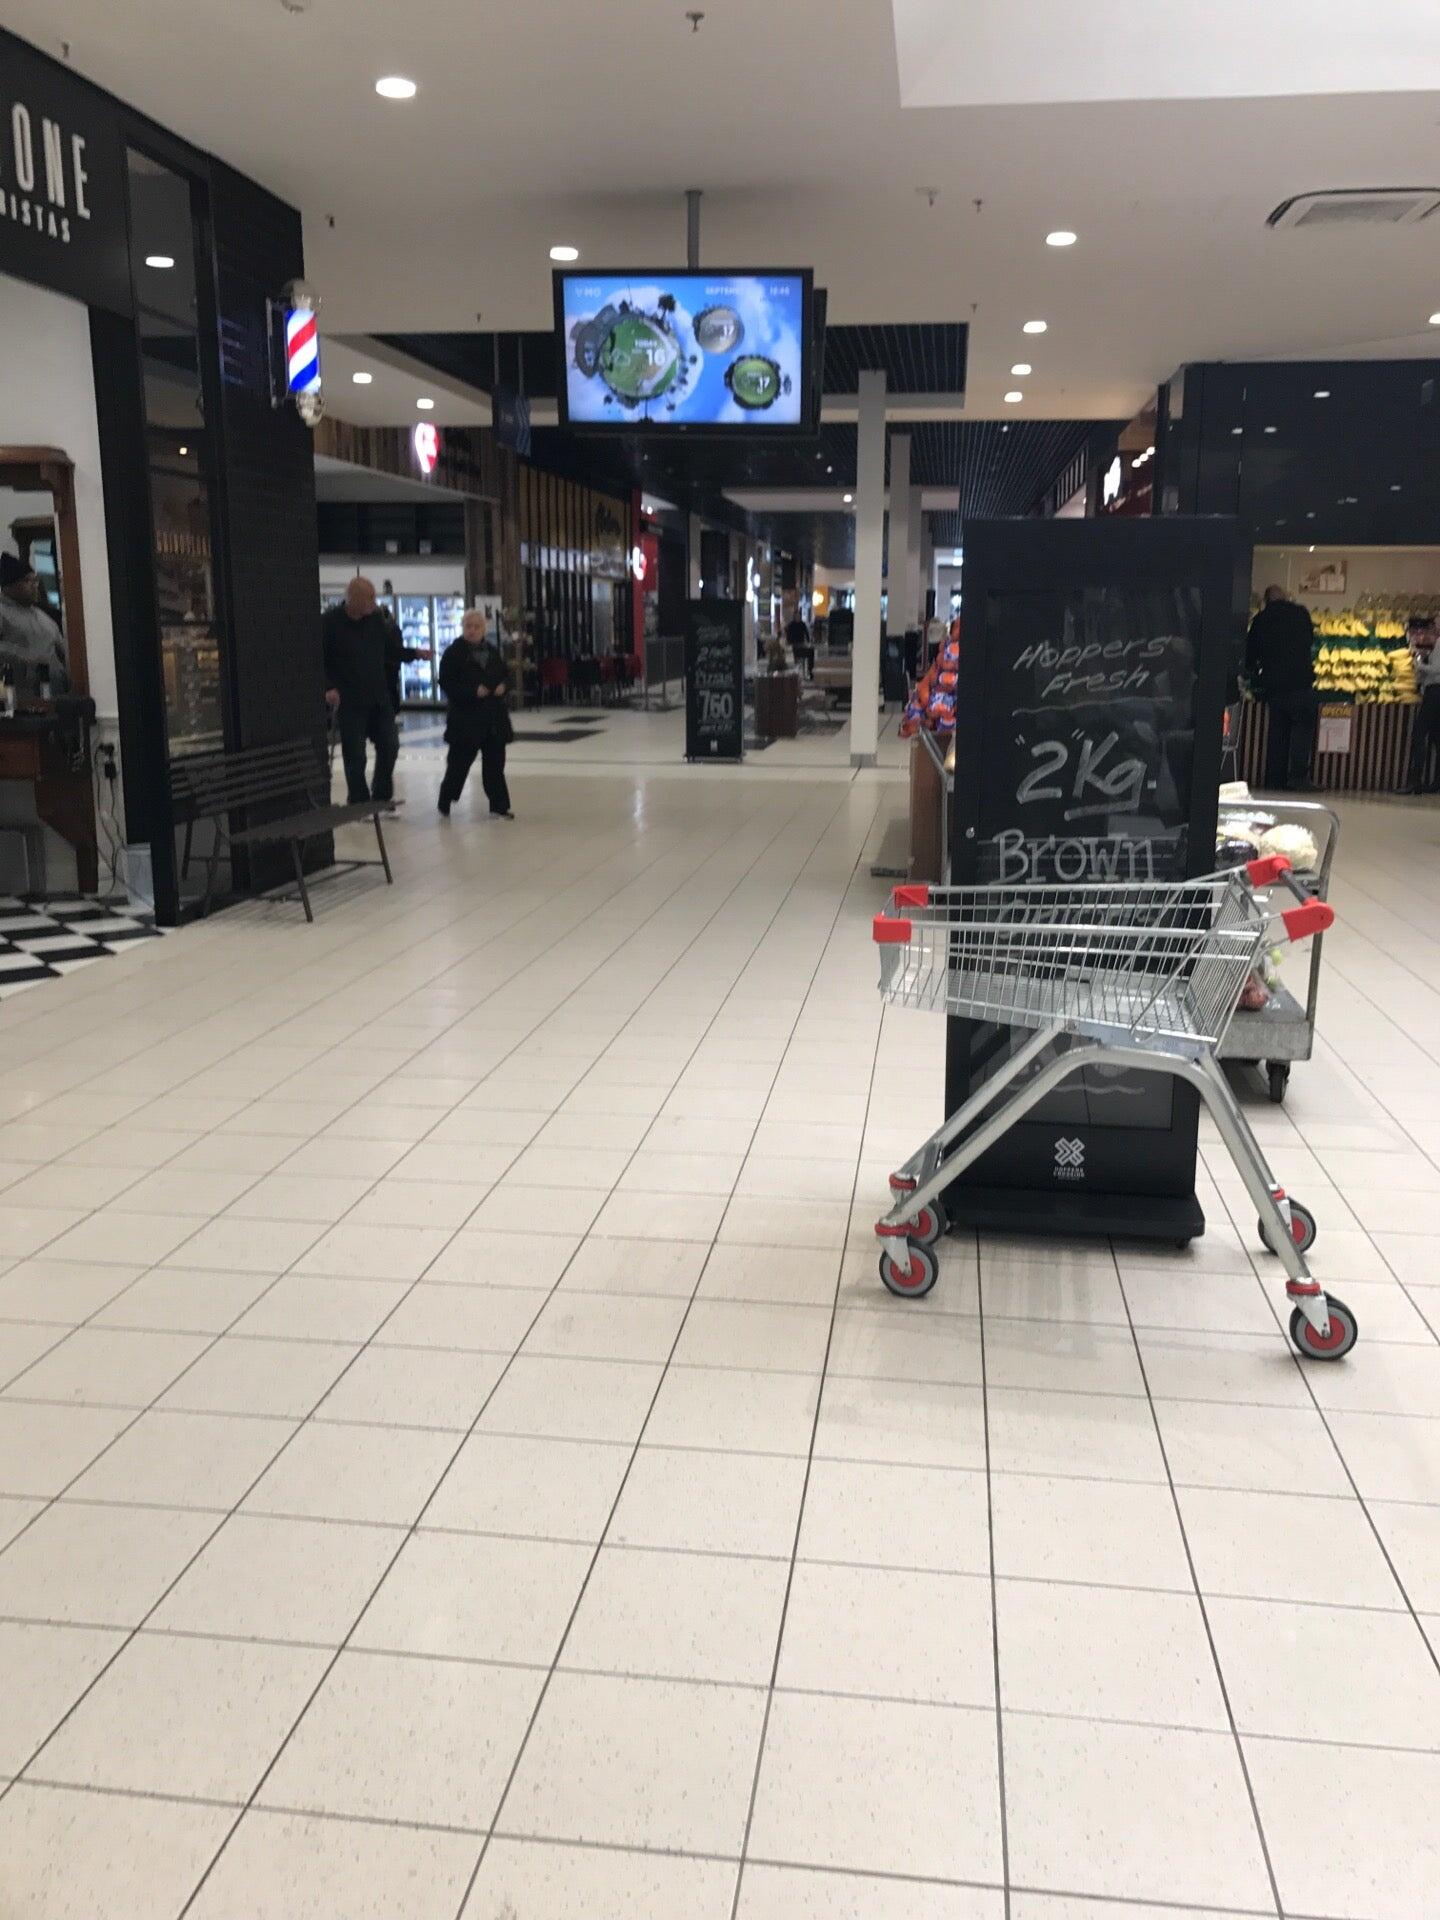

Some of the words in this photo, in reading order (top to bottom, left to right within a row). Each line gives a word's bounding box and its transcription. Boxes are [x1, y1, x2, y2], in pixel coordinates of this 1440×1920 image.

[12, 102, 91, 220] ONE
[1012, 636, 1173, 671] Hoppers
[1041, 664, 1151, 698] Fresh
[988, 828, 1162, 885] Brown
